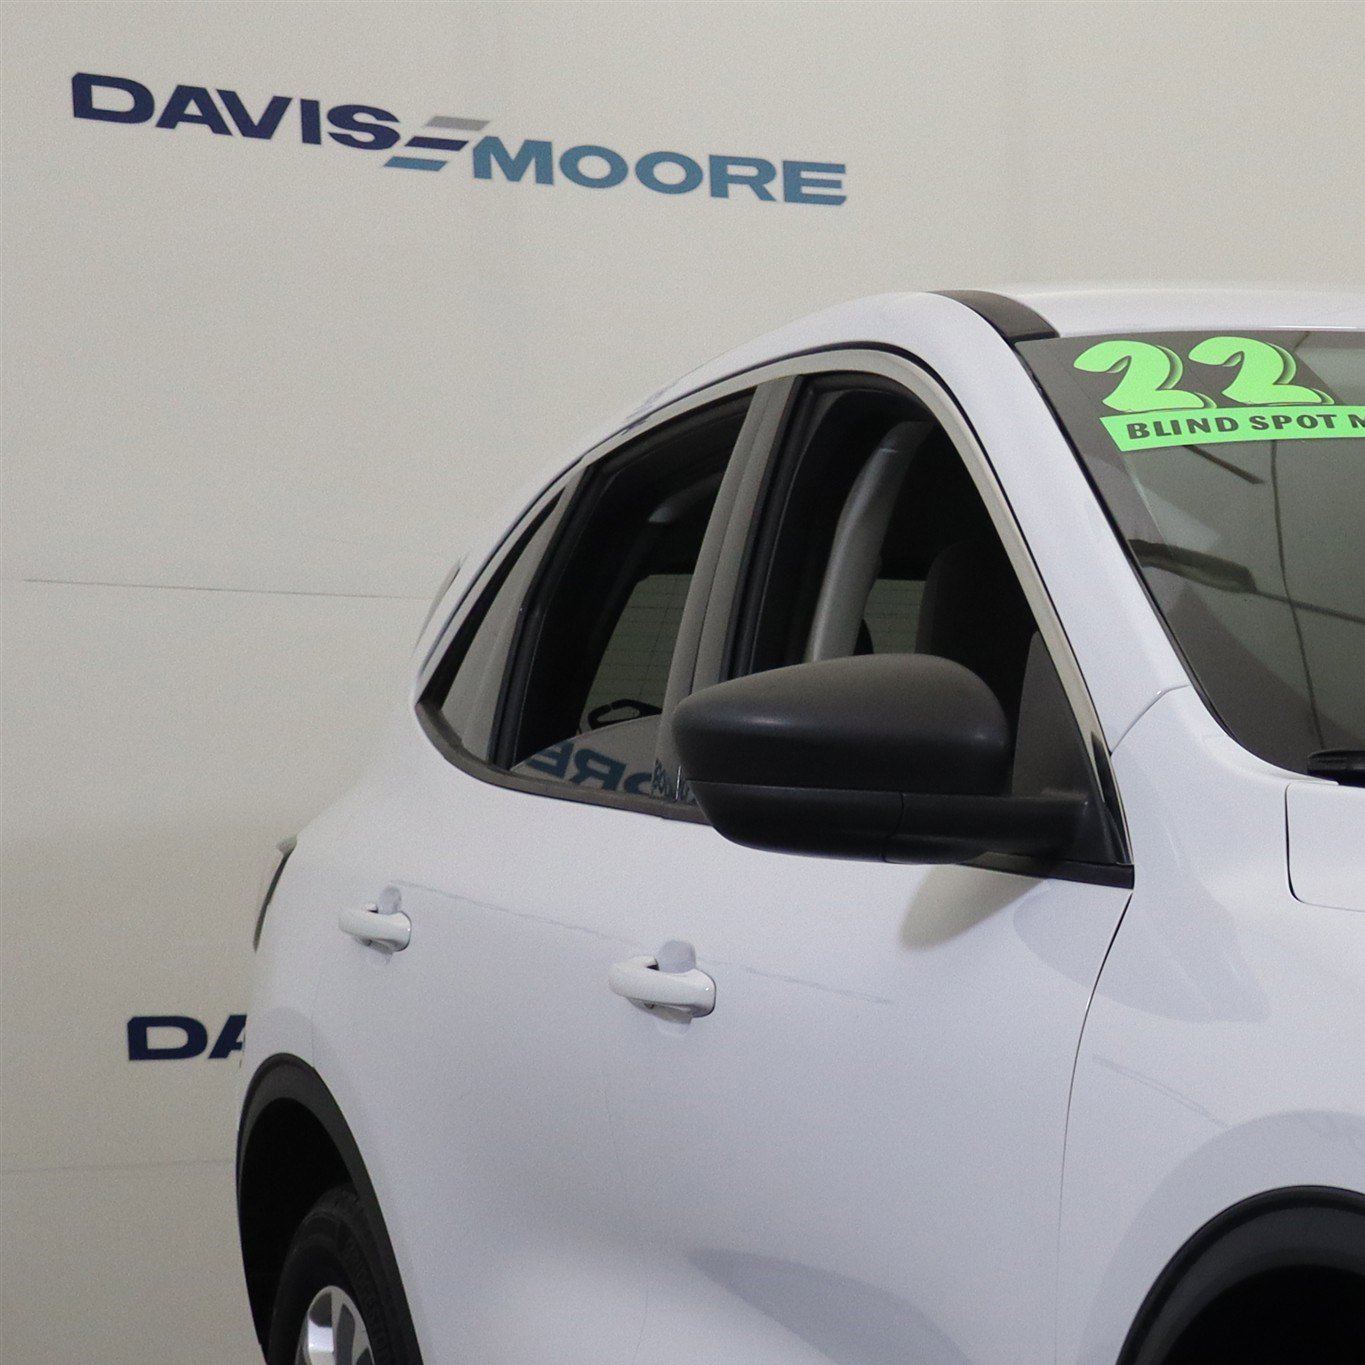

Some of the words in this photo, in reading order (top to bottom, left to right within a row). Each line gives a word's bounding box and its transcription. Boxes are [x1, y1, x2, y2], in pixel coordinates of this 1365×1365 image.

[71, 72, 401, 151] DAVIS
[472, 136, 847, 206] MOORE
[1073, 336, 1335, 413] 22
[1125, 414, 1240, 441] BLIND
[1250, 413, 1337, 431] SPOT
